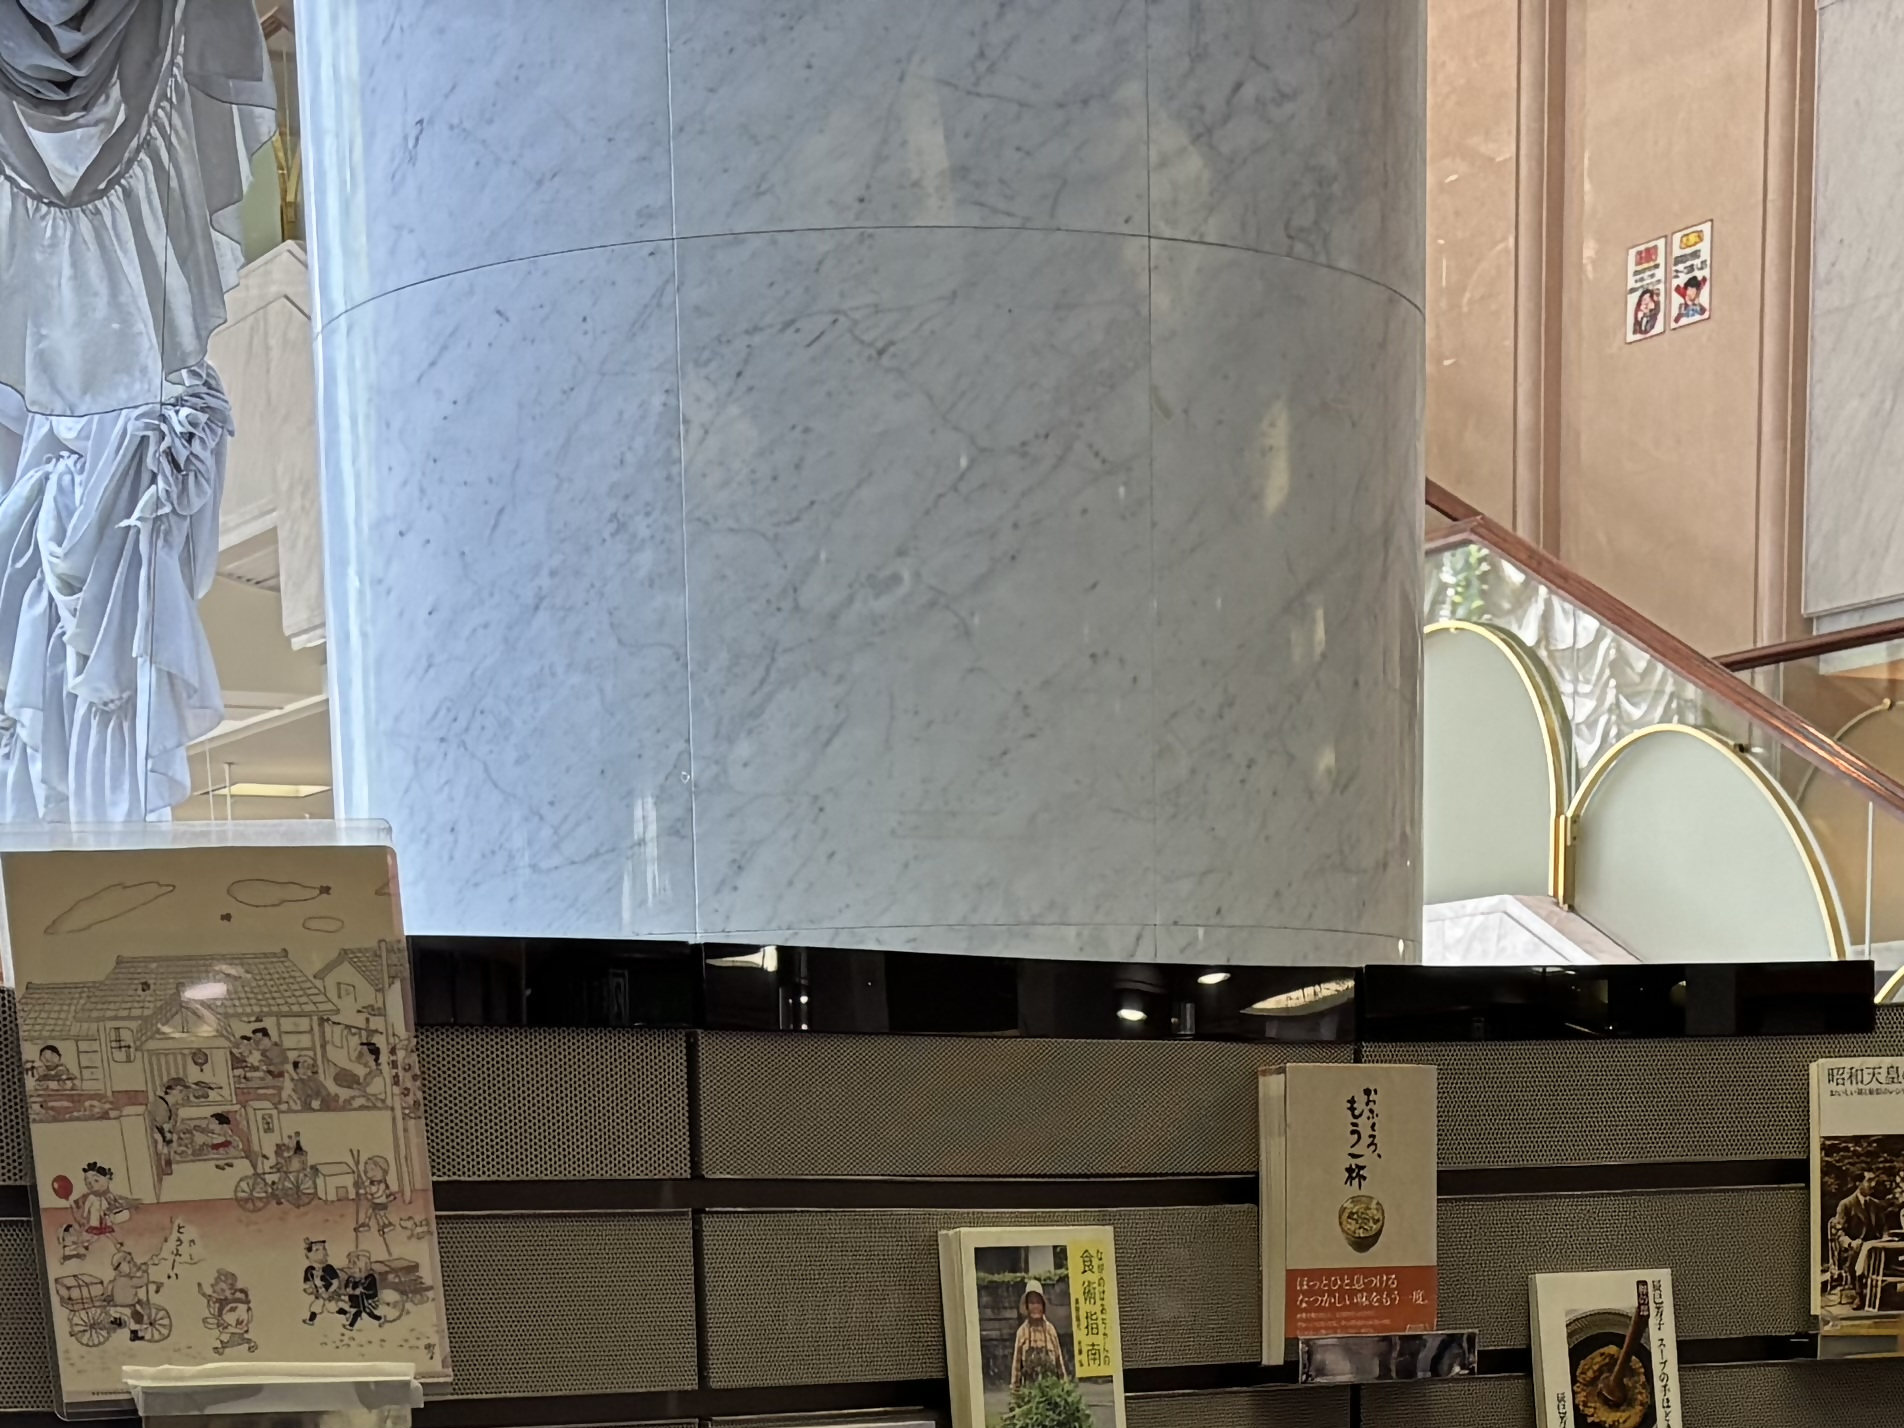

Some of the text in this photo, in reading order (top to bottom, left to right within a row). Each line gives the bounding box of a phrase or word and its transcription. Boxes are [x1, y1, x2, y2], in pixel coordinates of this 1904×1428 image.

[1344, 1095, 1367, 1191] もう一杯
[1080, 1249, 1101, 1367] 食術指南
